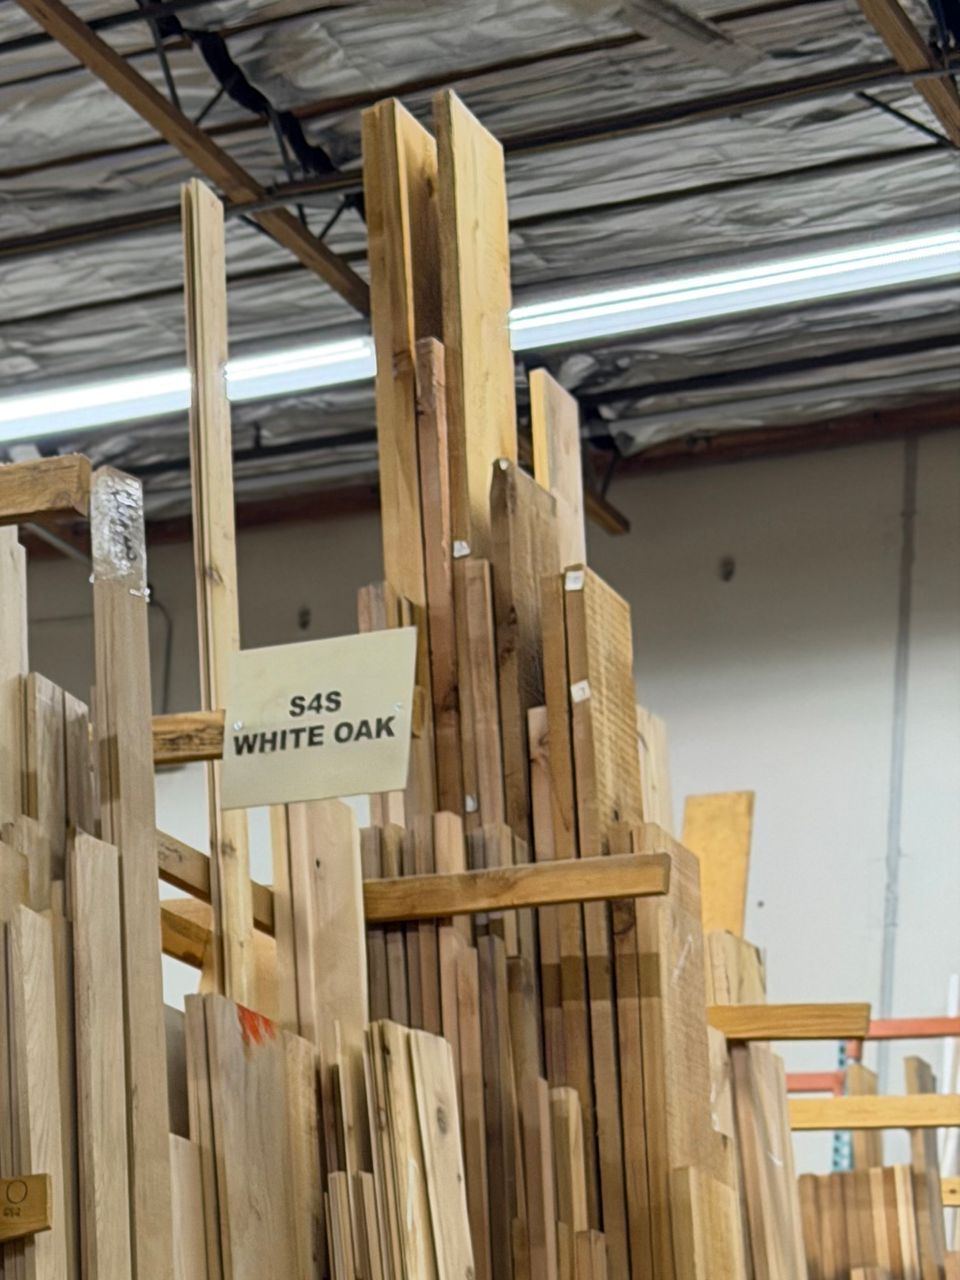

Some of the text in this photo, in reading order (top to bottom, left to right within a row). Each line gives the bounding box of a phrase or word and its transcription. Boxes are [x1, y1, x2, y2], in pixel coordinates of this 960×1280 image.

[289, 691, 342, 717] S4S
[233, 716, 396, 756] WHITE OAK
